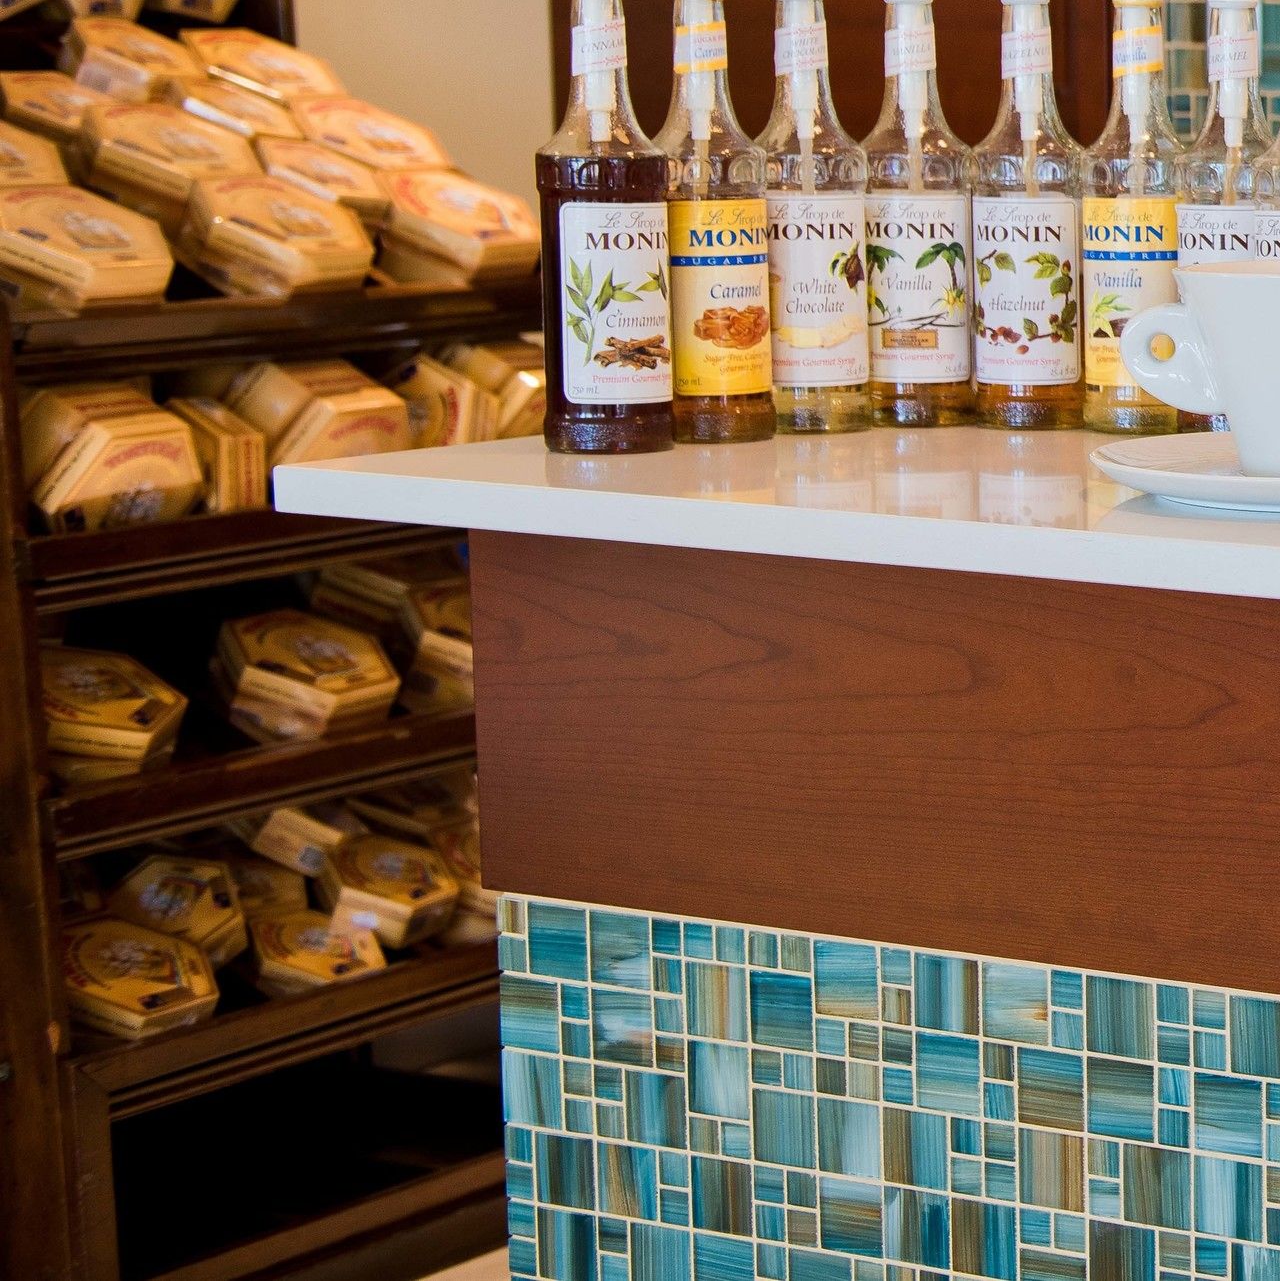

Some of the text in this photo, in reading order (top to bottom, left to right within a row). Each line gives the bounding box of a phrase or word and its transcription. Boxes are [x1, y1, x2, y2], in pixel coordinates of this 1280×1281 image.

[769, 203, 846, 224] Le Sirop de
[892, 203, 930, 224] Sirop
[932, 207, 947, 219] de
[981, 205, 1052, 227] Le Sirop de
[1137, 211, 1153, 222] de
[866, 222, 956, 240] MONIN
[977, 225, 1061, 243] MONIN
[1083, 224, 1164, 242] MONIN
[1189, 213, 1220, 235] Sirop
[1223, 218, 1238, 229] de
[680, 256, 744, 265] SUGAR
[1129, 252, 1173, 260] FREE
[709, 276, 763, 300] Caramel
[793, 276, 839, 296] White
[880, 272, 933, 292] Vanilla
[1093, 268, 1143, 288] Vanilla
[785, 295, 845, 315] Chocolate
[988, 293, 1045, 313] Hazelnut
[801, 357, 836, 368] Gourmet
[899, 352, 936, 362] Gourmet
[936, 351, 956, 364] Syrup
[1006, 357, 1040, 367] Gourmet
[1040, 357, 1061, 368] Syrup
